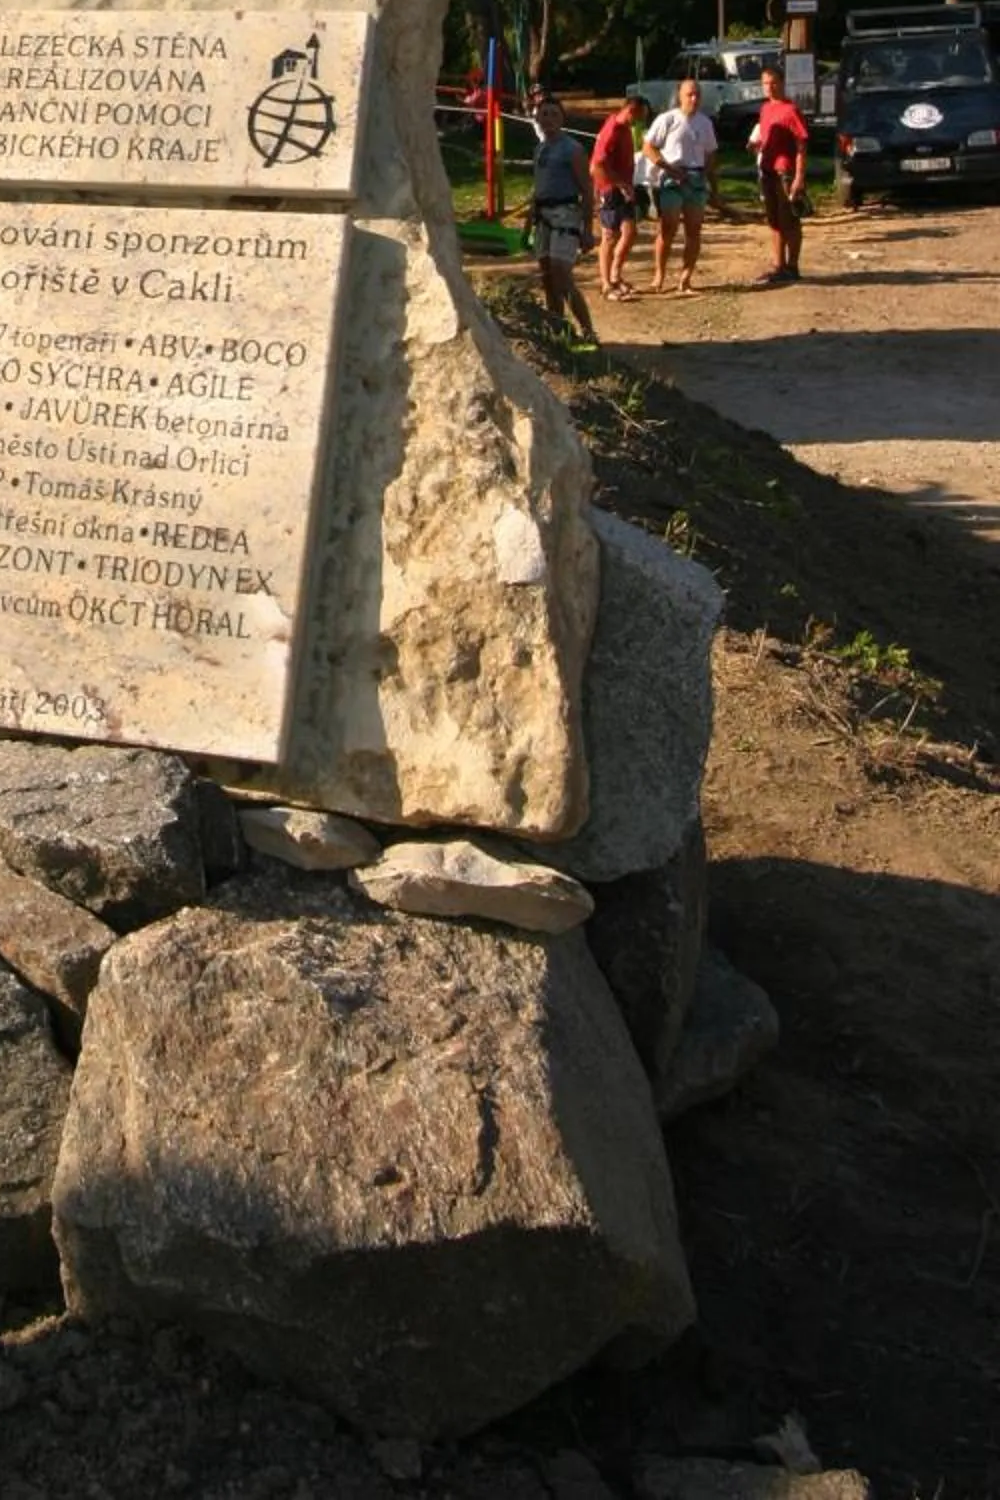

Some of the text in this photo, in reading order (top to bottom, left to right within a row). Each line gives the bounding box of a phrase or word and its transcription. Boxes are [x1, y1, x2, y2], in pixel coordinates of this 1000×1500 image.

[133, 31, 228, 60] STĚNA
[7, 64, 206, 93] REALIZOVÁNA
[95, 102, 212, 127] POMOCI
[127, 136, 221, 163] KRAJE
[103, 229, 308, 261] sponzorům
[112, 275, 130, 296] v
[139, 268, 233, 303] Cakli
[138, 334, 199, 359] ABV
[220, 338, 307, 367] BOCO
[166, 371, 255, 401] AGILE
[20, 394, 149, 431] JAVŮREK
[155, 407, 289, 442] betonárna
[123, 444, 169, 471] nad
[25, 471, 105, 501] Tomáš
[111, 478, 203, 517] Krásný
[73, 515, 134, 543] okna
[151, 521, 249, 555] REDEA
[151, 601, 251, 639] HORAL
